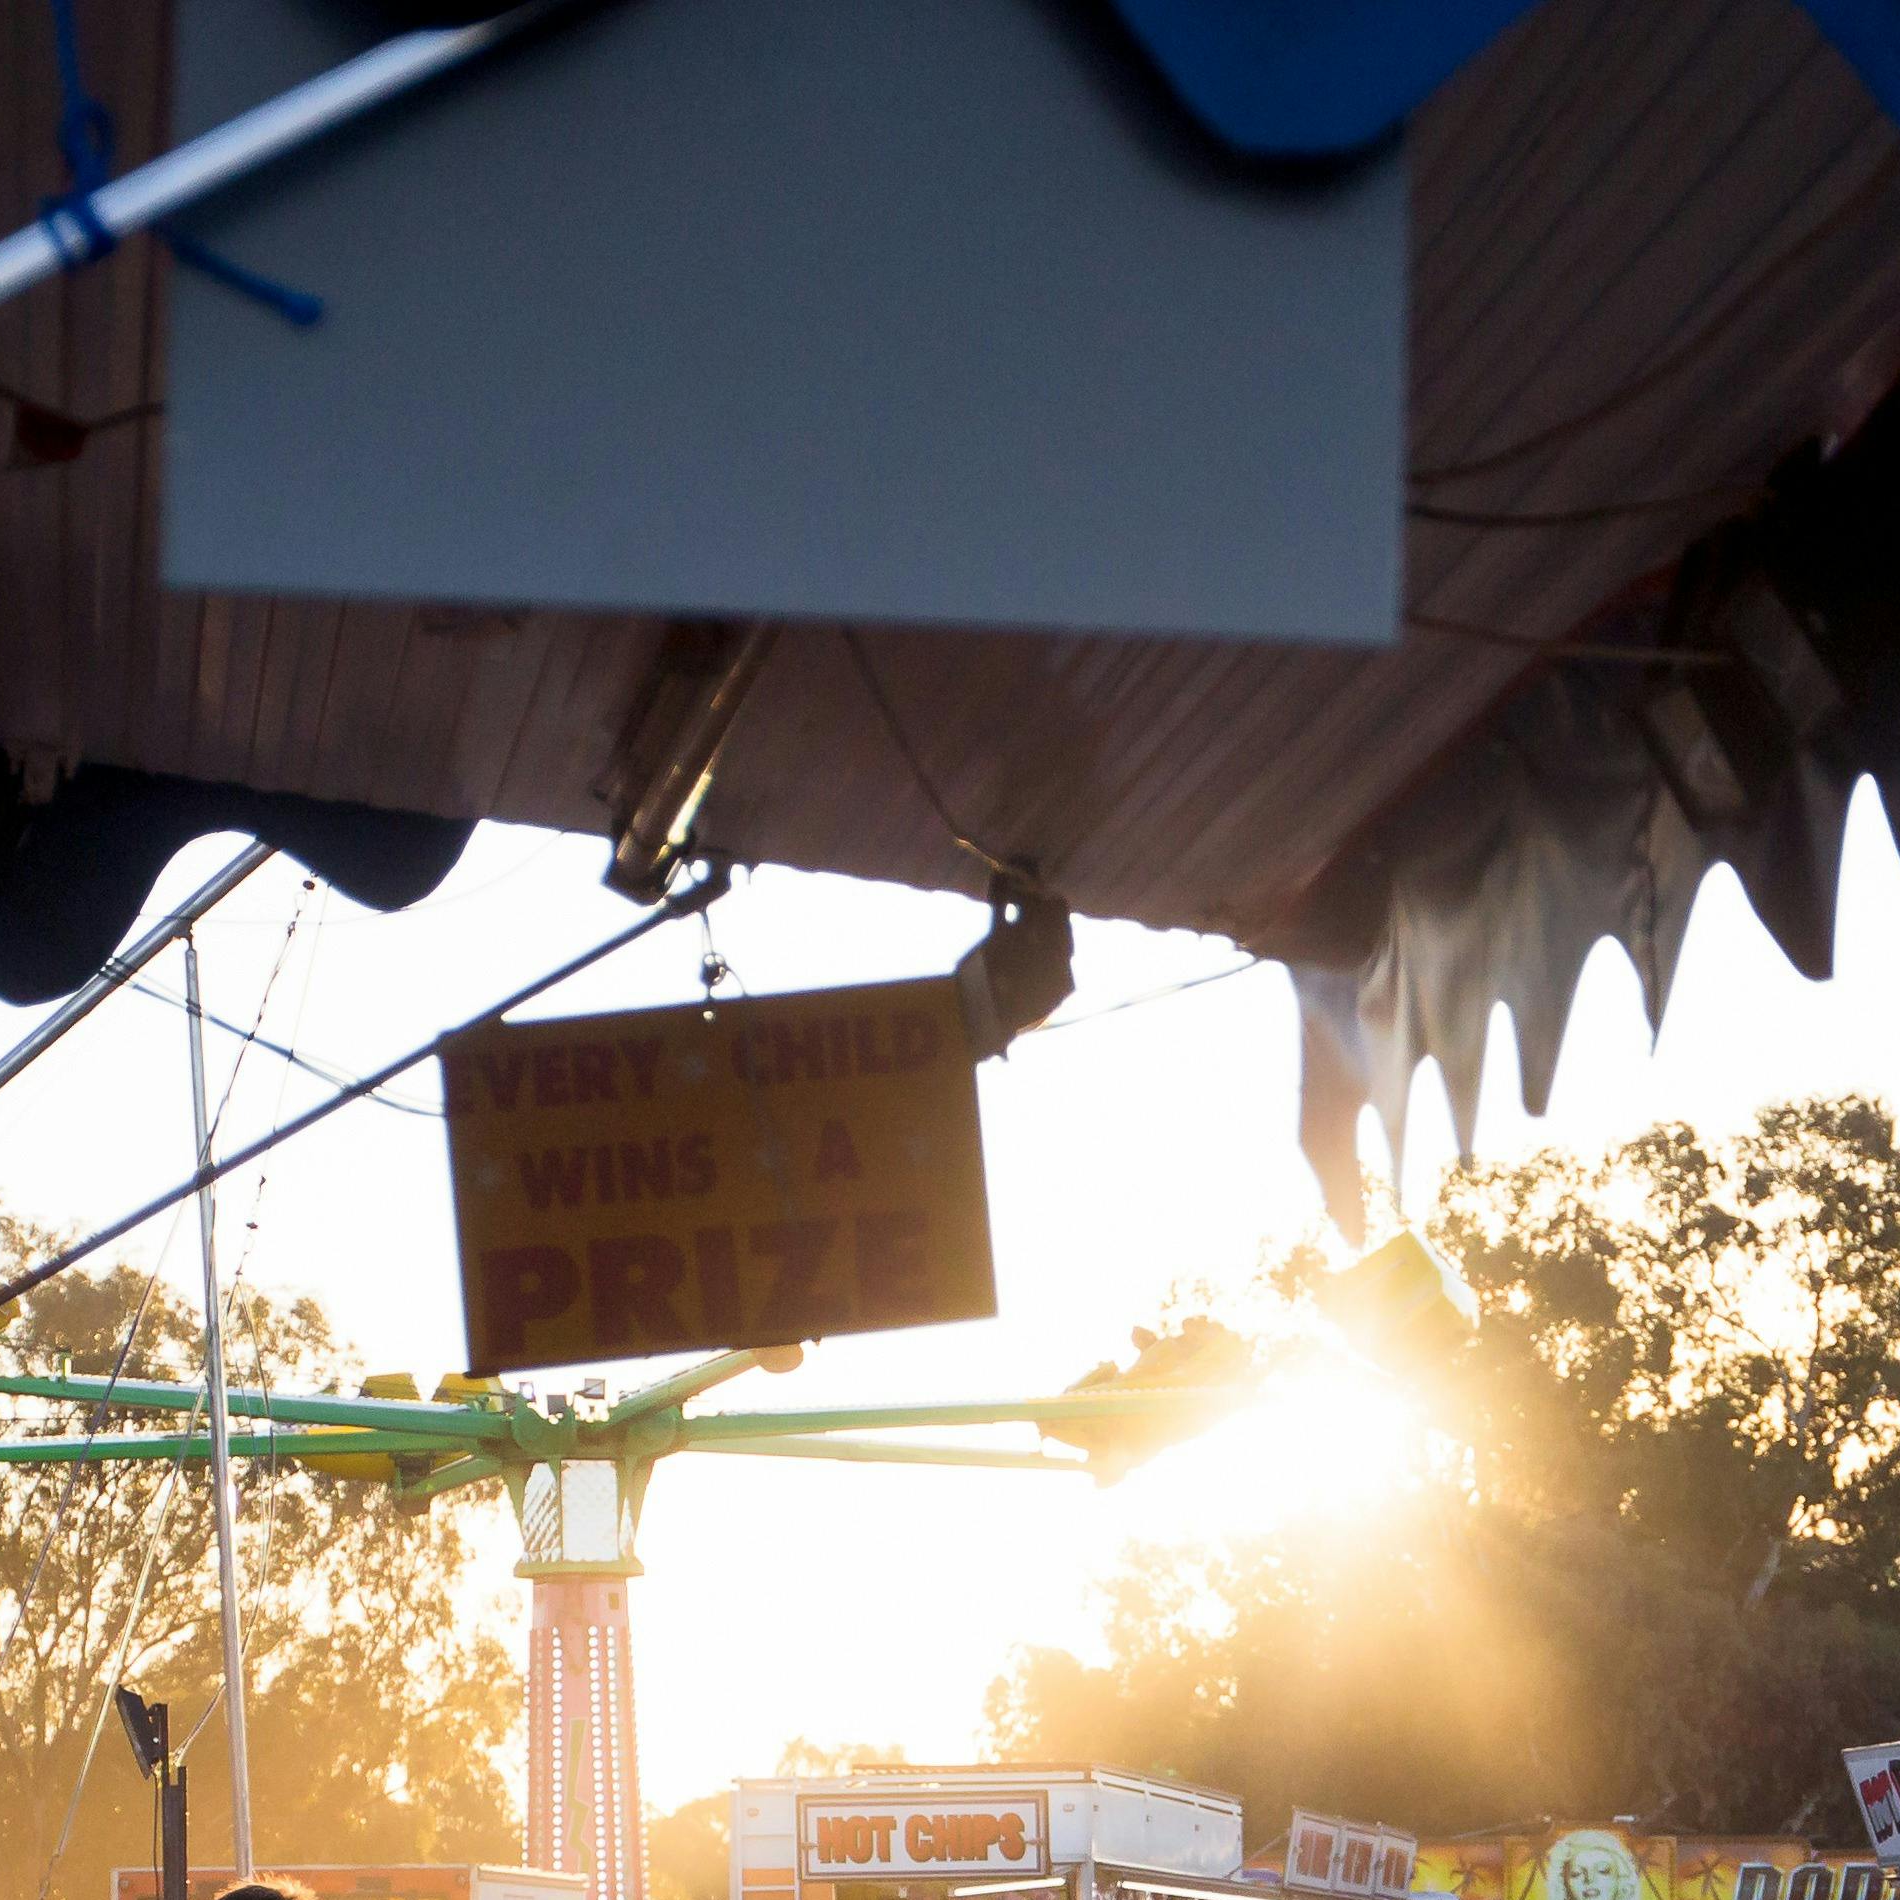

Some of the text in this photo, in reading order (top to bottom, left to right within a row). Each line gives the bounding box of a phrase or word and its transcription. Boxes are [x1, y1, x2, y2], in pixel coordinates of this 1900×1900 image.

[731, 1013, 940, 1084] CHILD
[519, 1118, 860, 1210] WINS A
[479, 1210, 932, 1358] PRIZE
[817, 1812, 1026, 1863] HOT CHIPS
